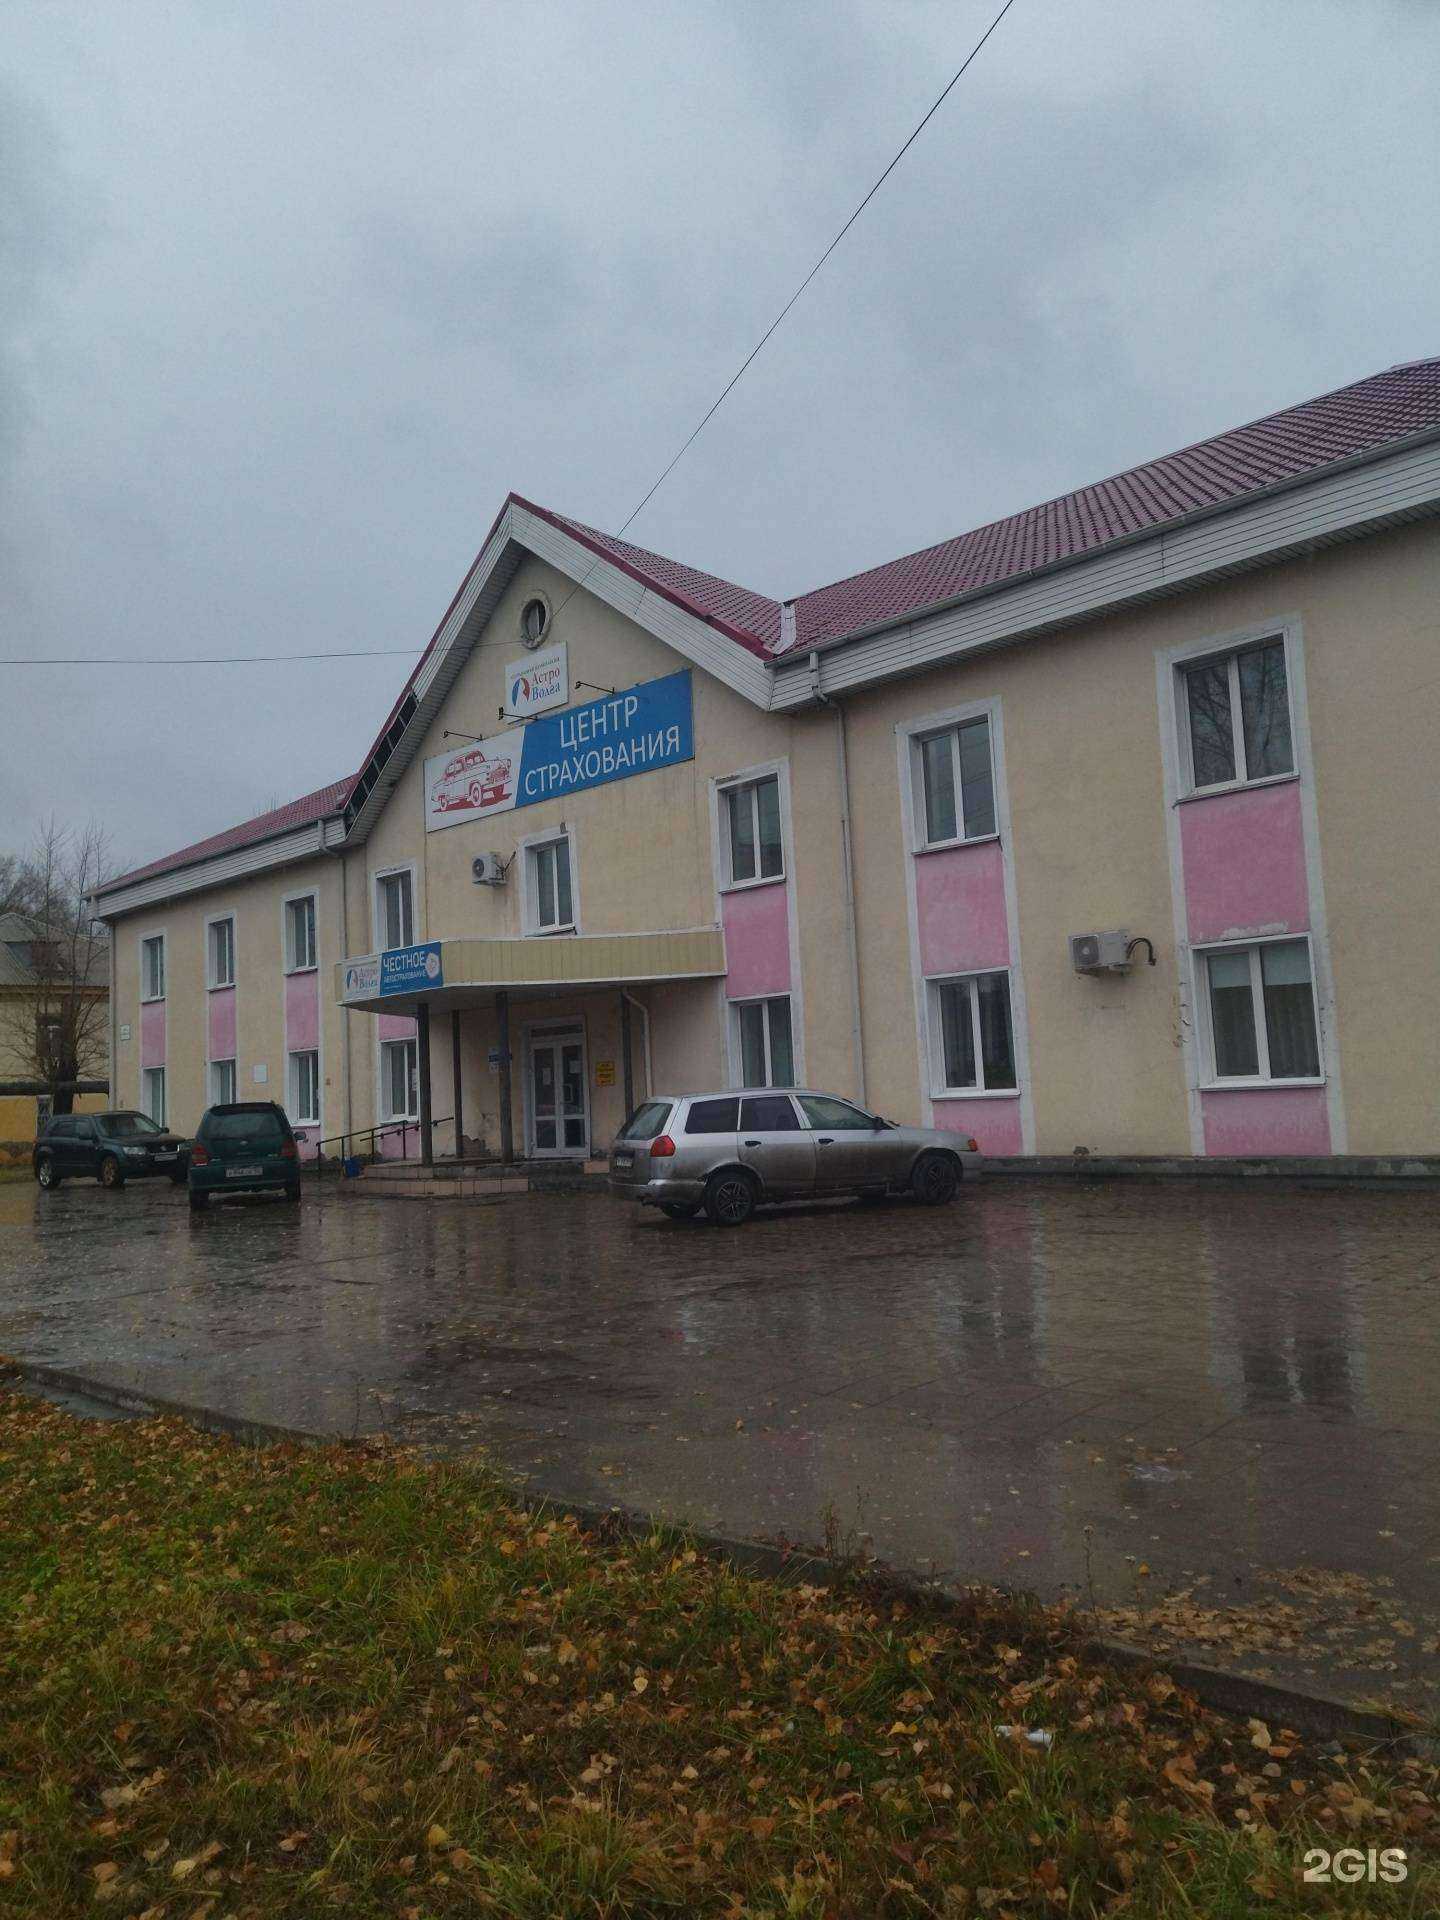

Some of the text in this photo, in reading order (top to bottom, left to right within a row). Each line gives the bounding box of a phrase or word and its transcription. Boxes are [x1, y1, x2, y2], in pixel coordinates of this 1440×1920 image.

[532, 667, 560, 685] Астро
[532, 682, 561, 700] Волга
[560, 696, 638, 751] ЦЕНТР
[525, 726, 680, 795] СТРАХОВАНИЯ
[383, 951, 426, 972] ЧЕСТНОЕ
